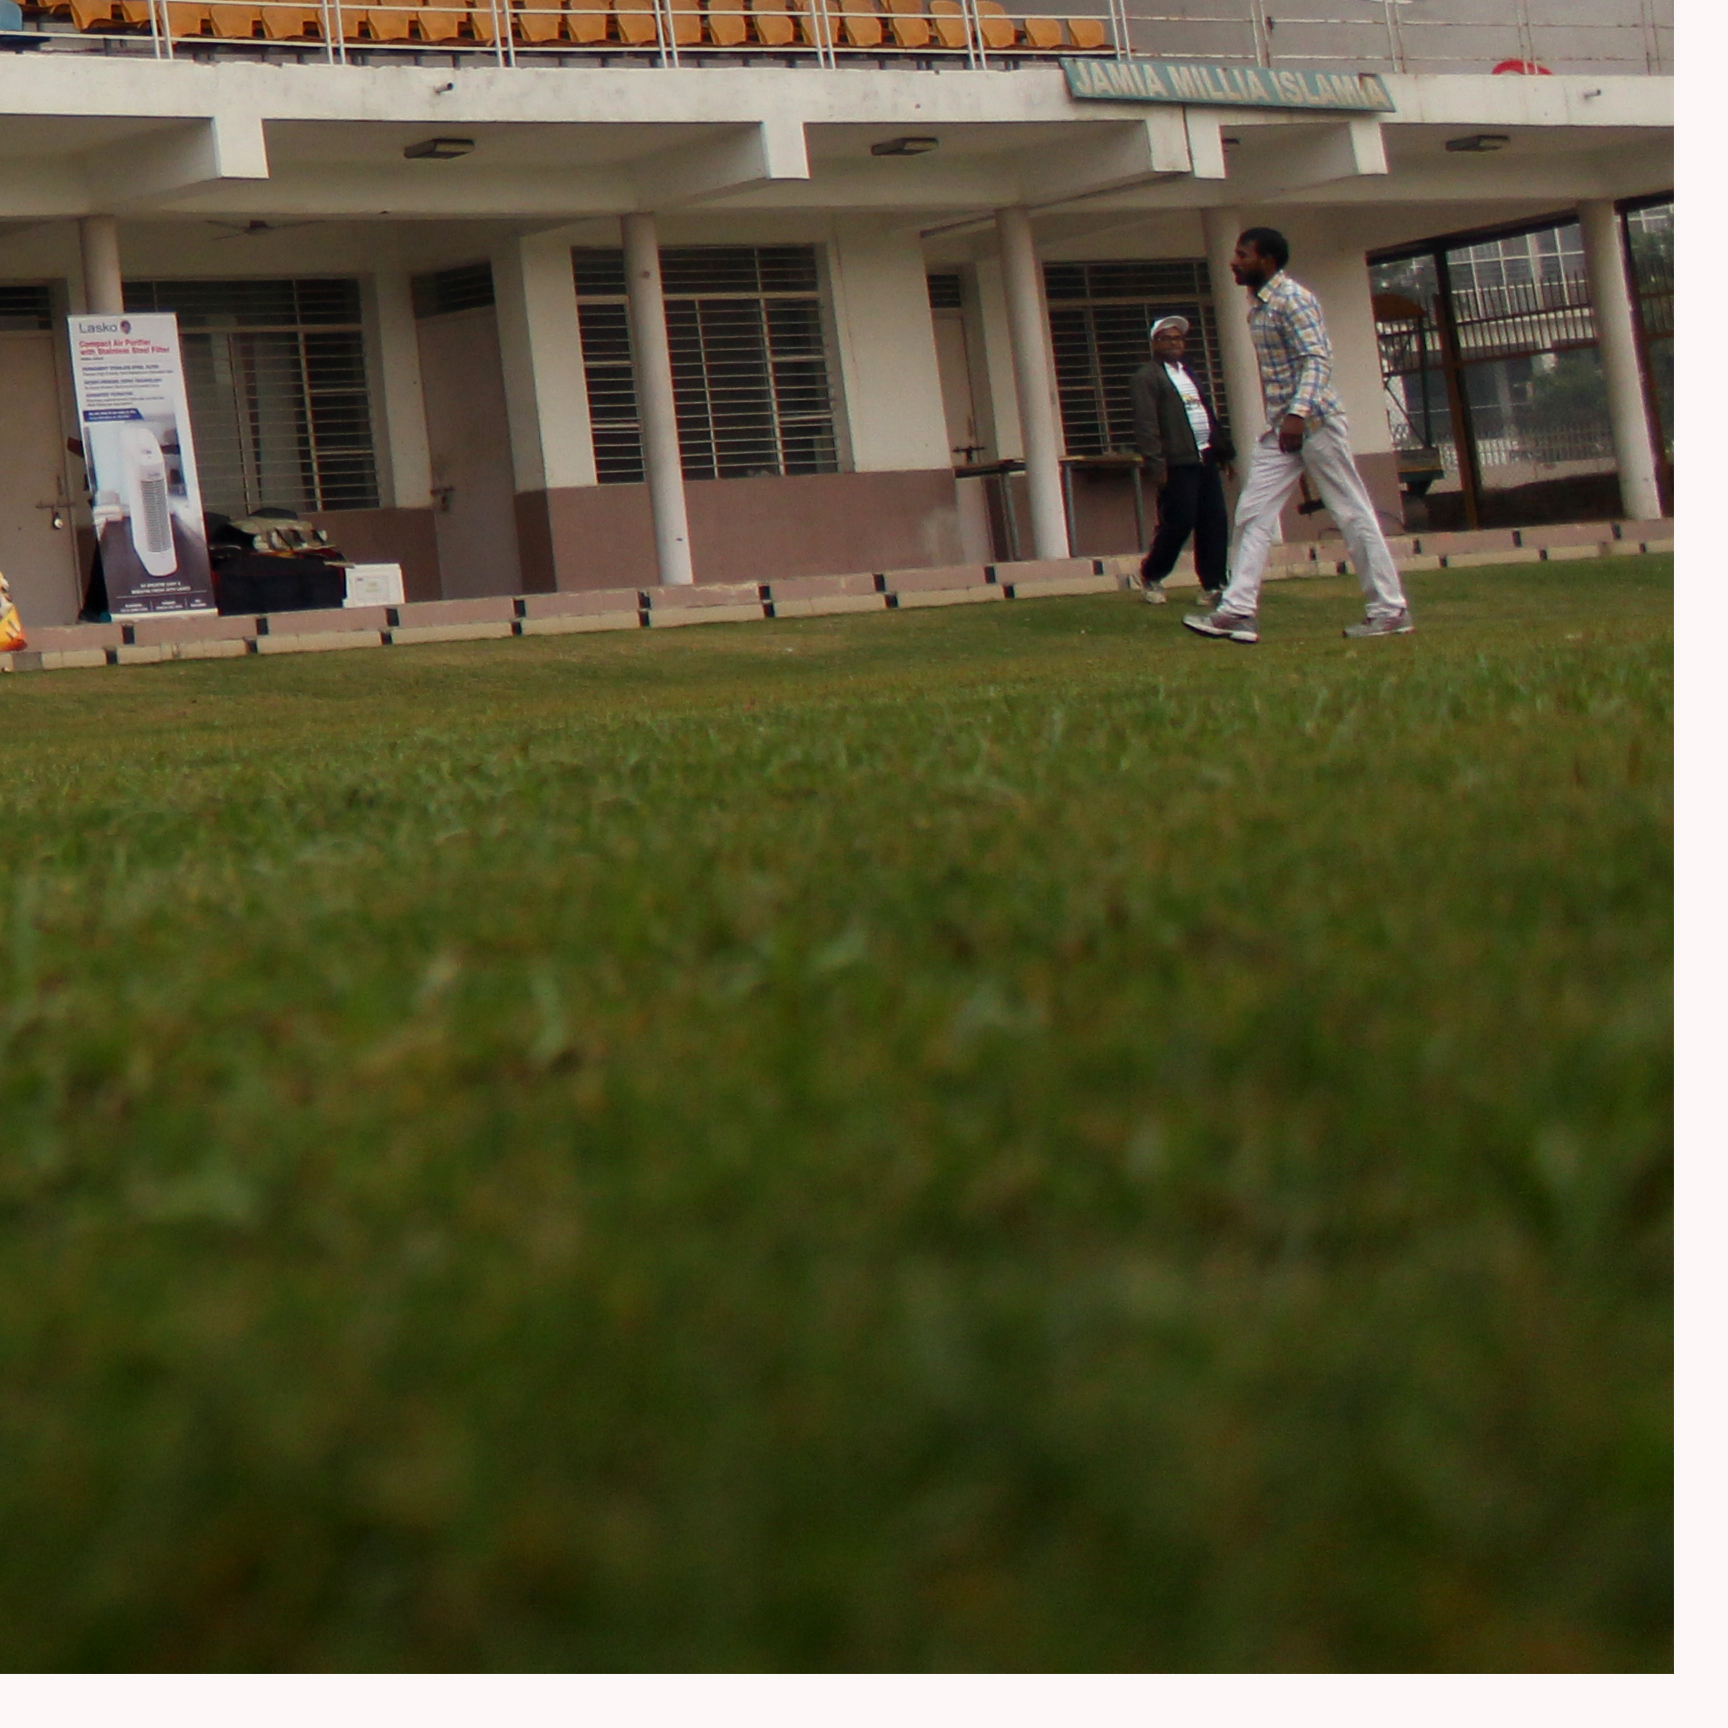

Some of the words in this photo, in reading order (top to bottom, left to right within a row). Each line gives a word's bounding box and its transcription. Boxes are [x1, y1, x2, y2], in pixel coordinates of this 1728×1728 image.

[1075, 62, 1169, 97] JAMIA
[1166, 65, 1271, 101] MILLIA
[1269, 69, 1391, 107] ISLAMIA
[79, 322, 118, 333] Lasko
